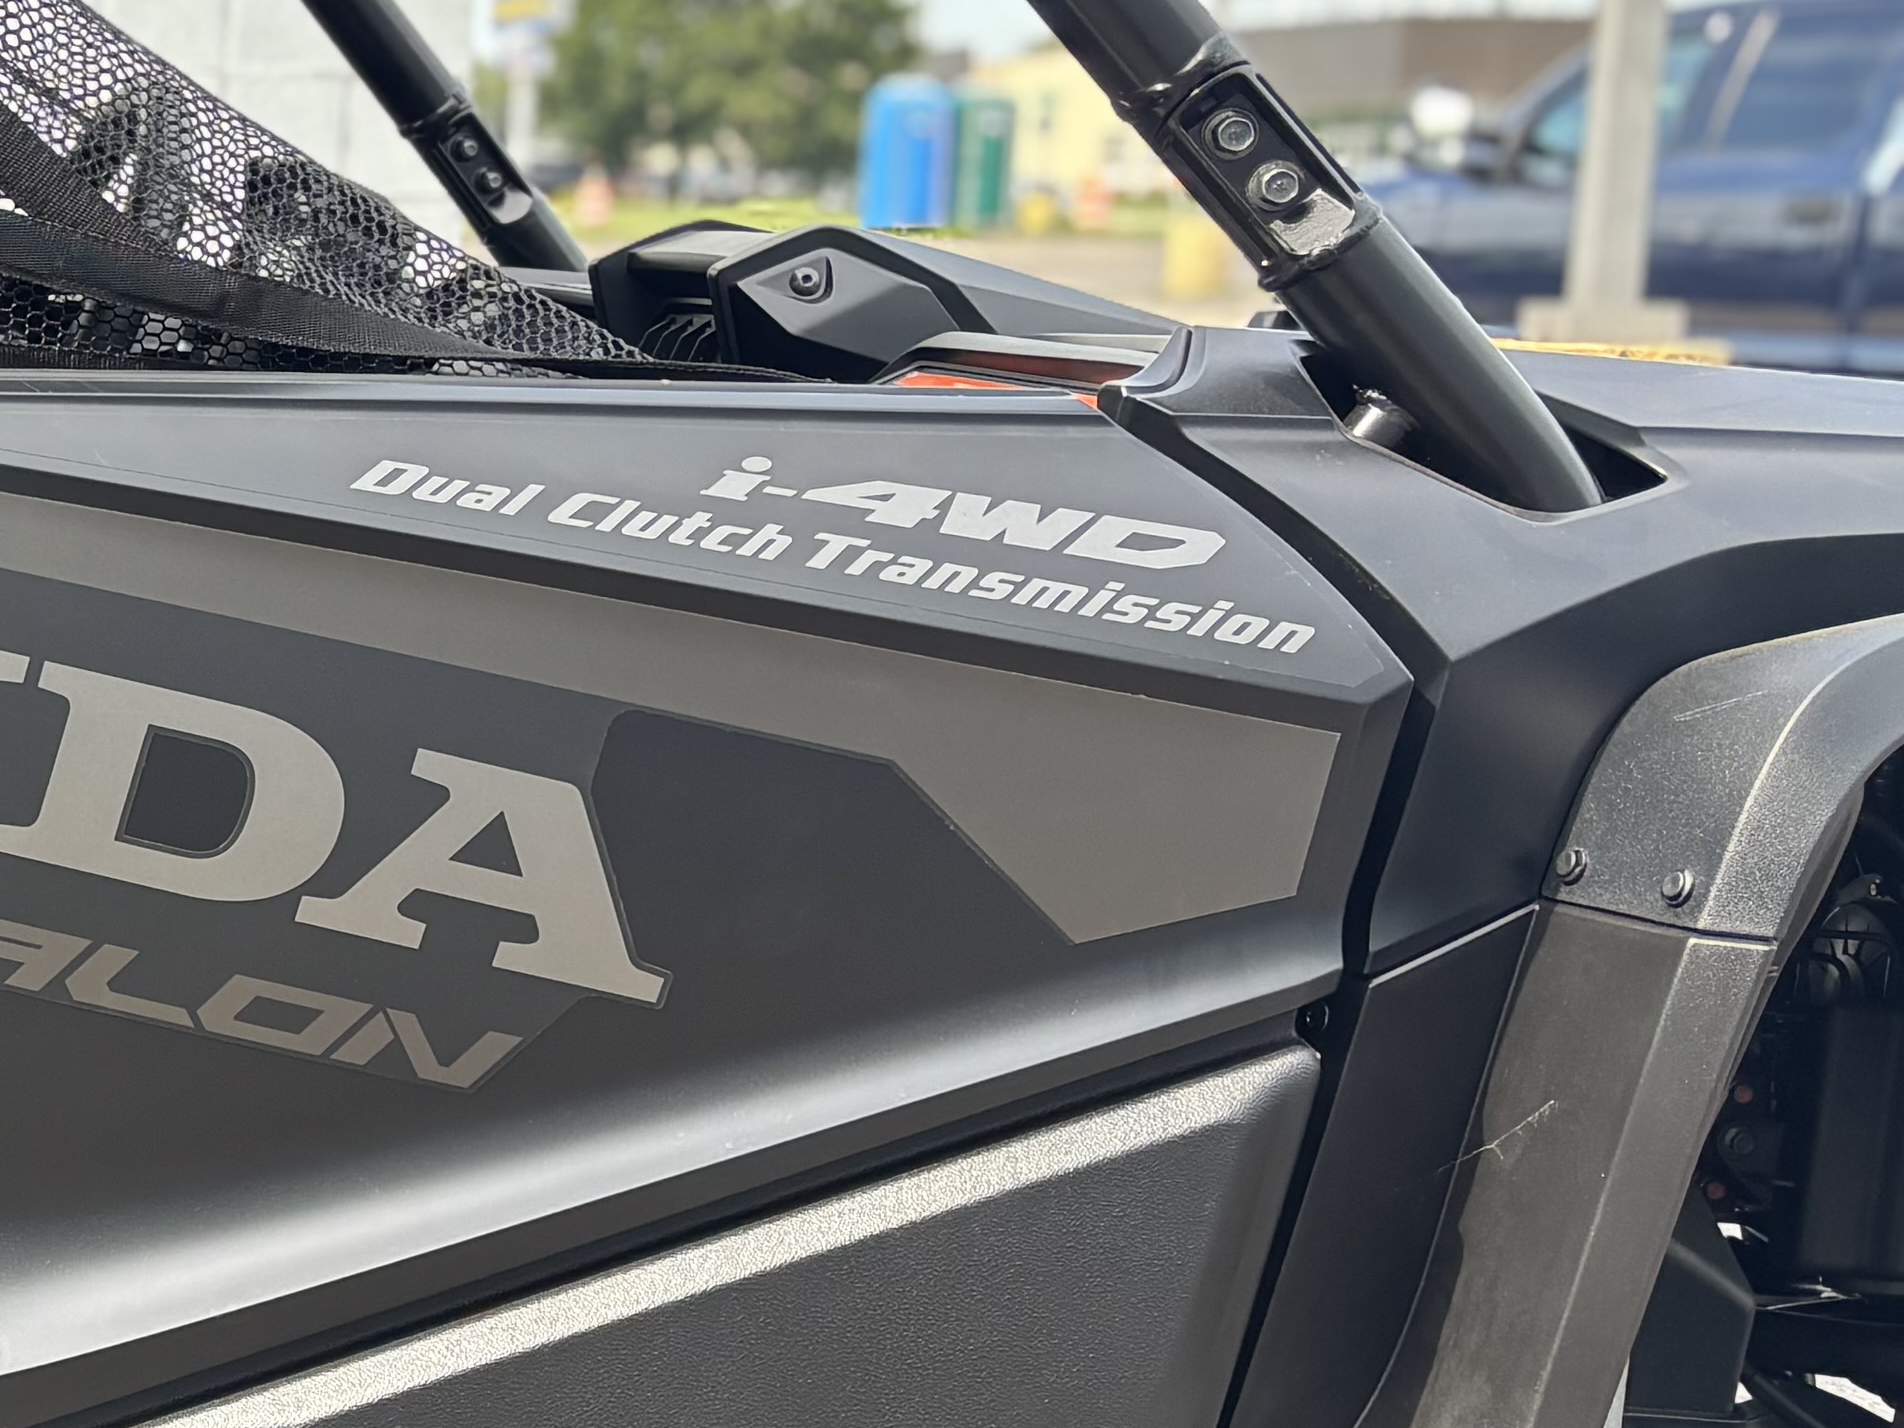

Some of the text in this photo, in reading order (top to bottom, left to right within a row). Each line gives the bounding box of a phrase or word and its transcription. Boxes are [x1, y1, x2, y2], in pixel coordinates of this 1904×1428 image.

[348, 458, 1316, 655] Dual Clutch Transmission
[699, 455, 1226, 570] i-4WD
